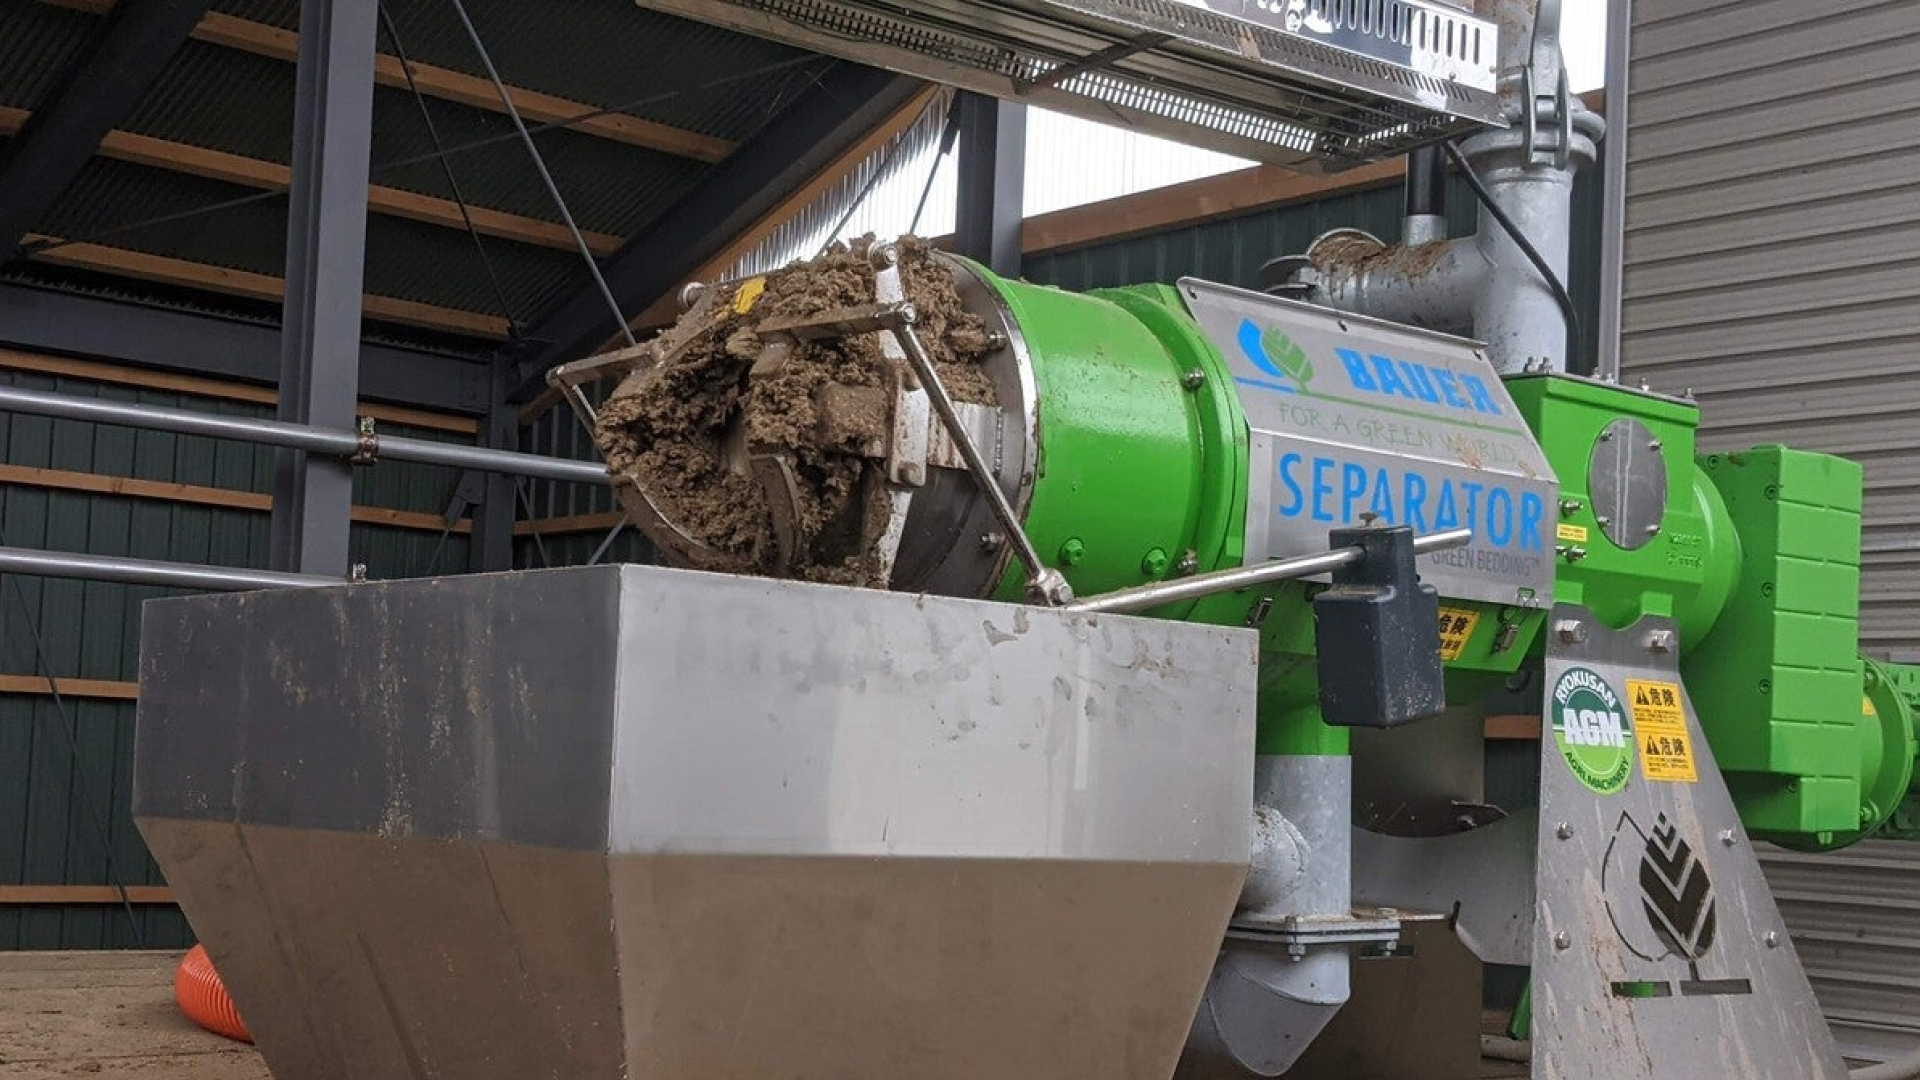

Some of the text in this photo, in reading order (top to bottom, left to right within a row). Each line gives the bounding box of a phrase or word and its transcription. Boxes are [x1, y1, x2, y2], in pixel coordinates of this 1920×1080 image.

[1335, 347, 1501, 415] BAUER
[1279, 402, 1328, 432] FOR
[1334, 413, 1350, 434] A
[1356, 418, 1433, 447] GREEN
[1279, 453, 1544, 550] SEPARATOR
[1431, 547, 1474, 569] GREEN
[1555, 671, 1616, 708] RYOKUSAN
[1649, 688, 1676, 707] 危険
[1563, 707, 1626, 748] AGM
[1660, 736, 1686, 756] 危険
